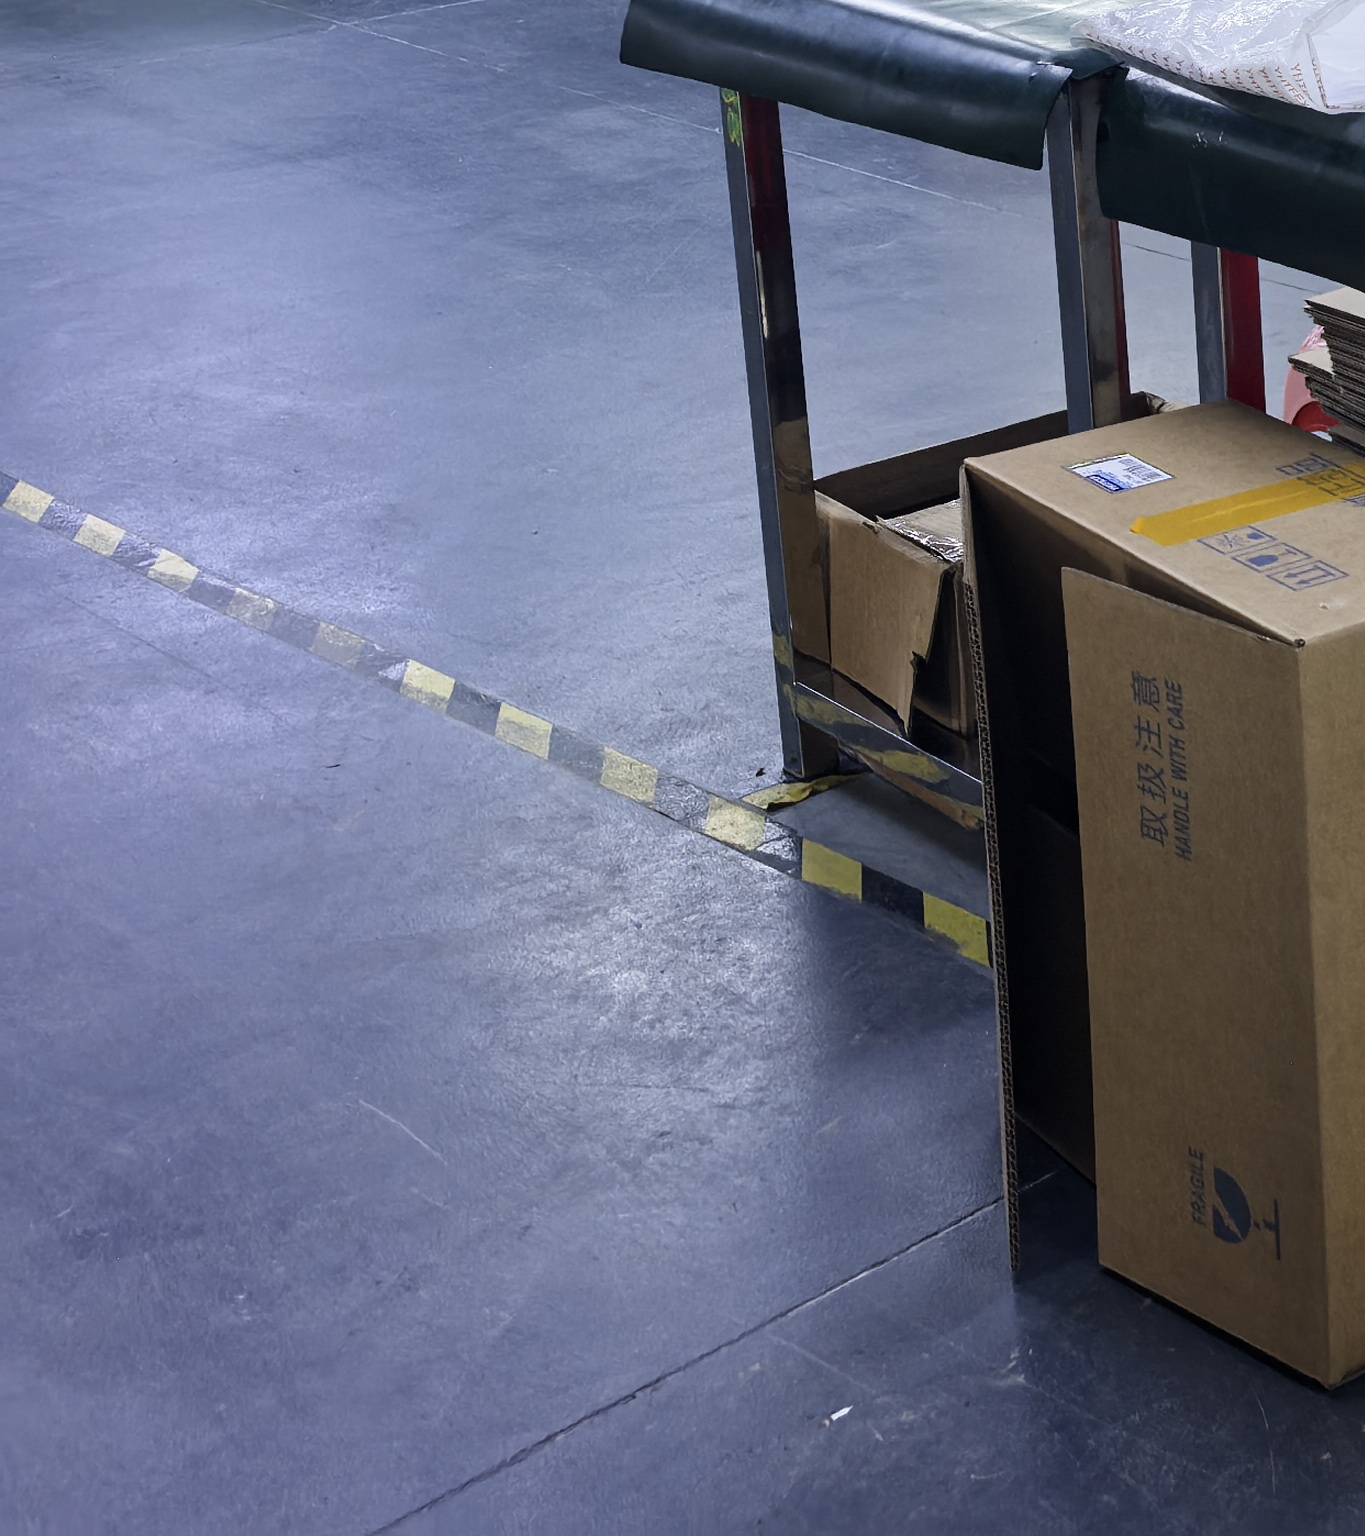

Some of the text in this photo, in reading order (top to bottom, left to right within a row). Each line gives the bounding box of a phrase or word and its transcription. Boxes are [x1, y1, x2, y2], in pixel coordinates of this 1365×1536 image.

[1131, 670, 1169, 847] 取扱注意
[1164, 675, 1192, 862] HANDLE WITH CARE
[1188, 1145, 1206, 1228] FRAGILE
